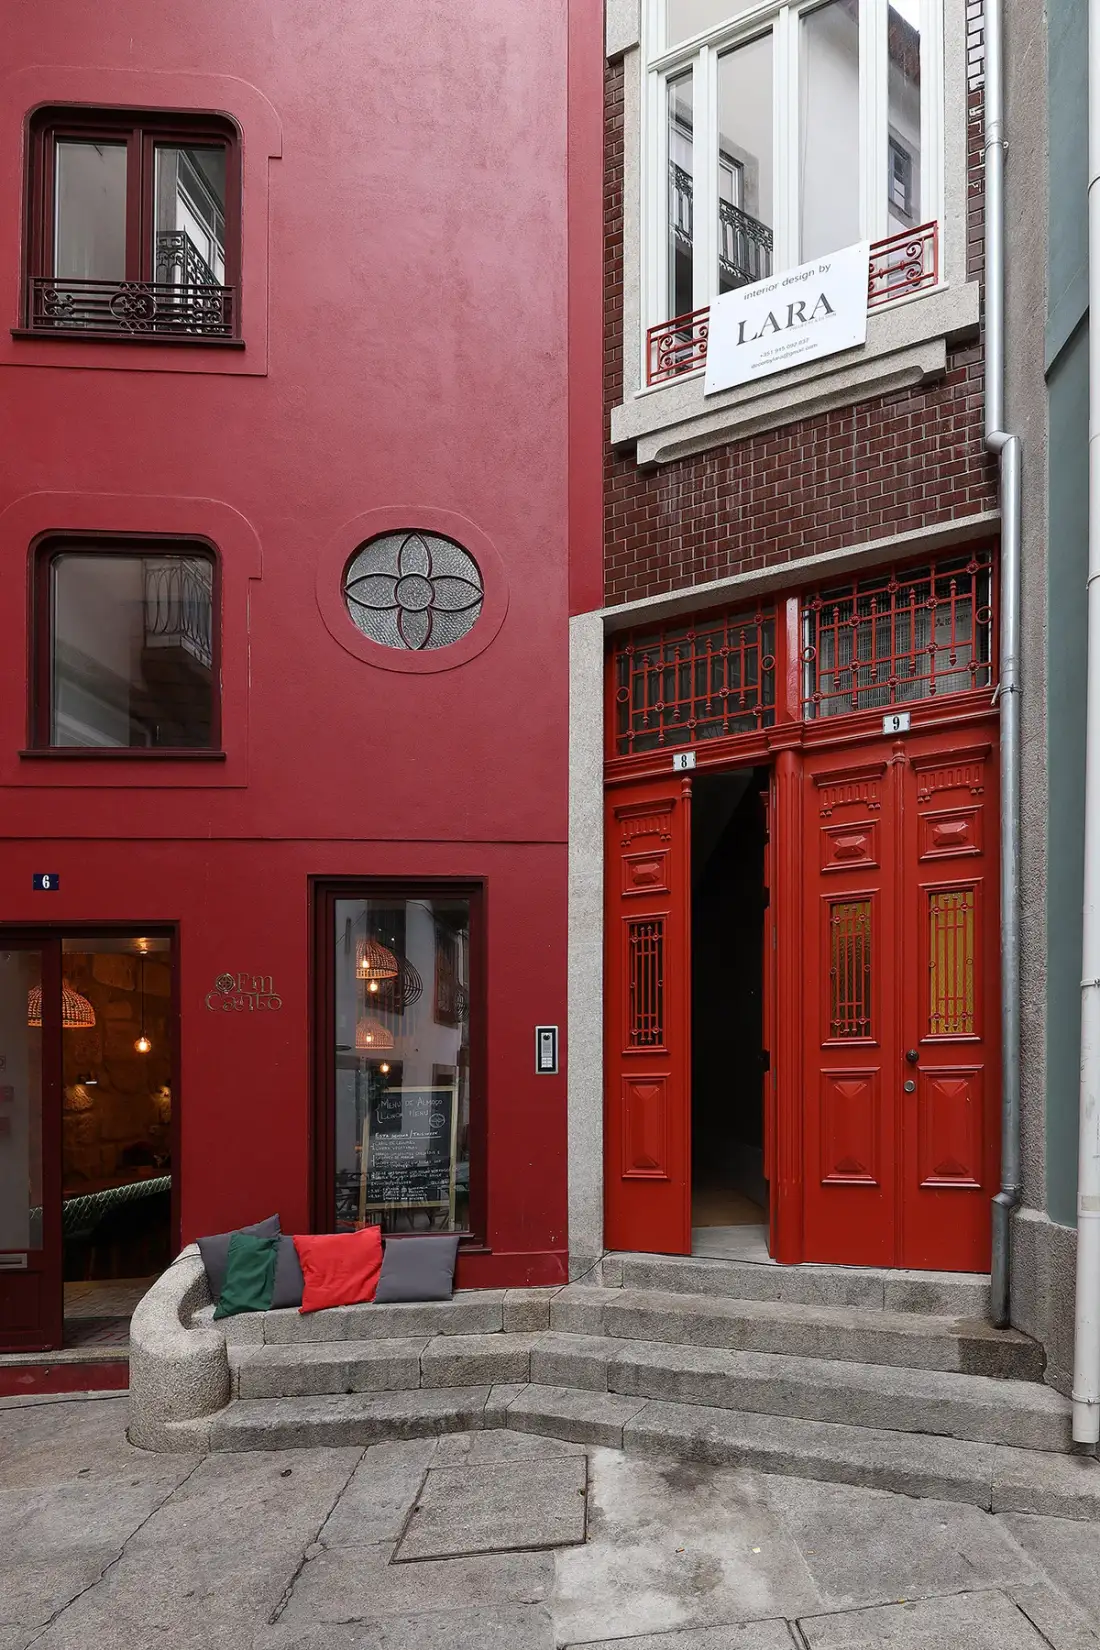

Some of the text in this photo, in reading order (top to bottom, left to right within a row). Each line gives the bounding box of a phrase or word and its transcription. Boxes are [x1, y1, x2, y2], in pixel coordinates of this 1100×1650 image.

[744, 263, 831, 300] interior design by
[736, 292, 835, 346] LARA
[892, 716, 900, 730] 9
[681, 754, 688, 768] 8
[42, 874, 50, 889] 6
[205, 991, 282, 1012] Canto
